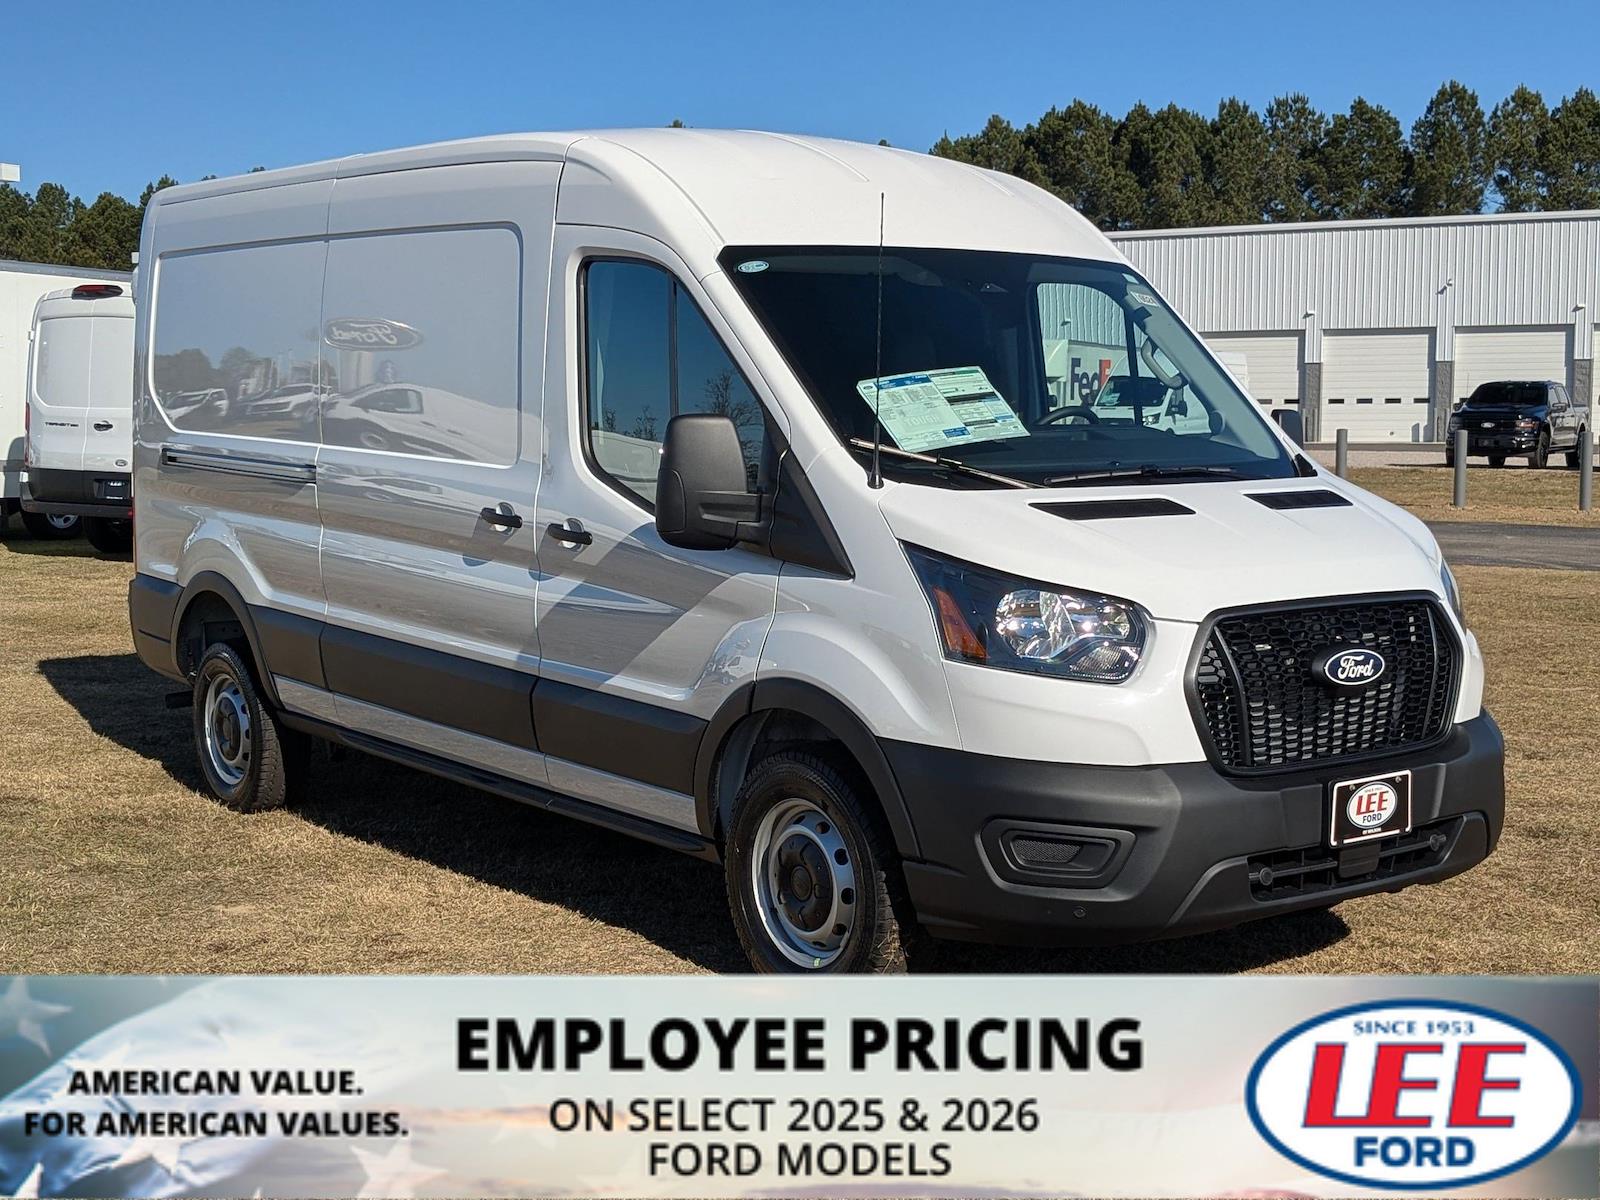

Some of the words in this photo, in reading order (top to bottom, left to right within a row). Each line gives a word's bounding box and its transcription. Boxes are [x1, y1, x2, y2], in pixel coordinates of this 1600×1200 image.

[1337, 655, 1375, 680] Ford
[1356, 790, 1389, 816] LEE
[1362, 813, 1382, 824] FORD
